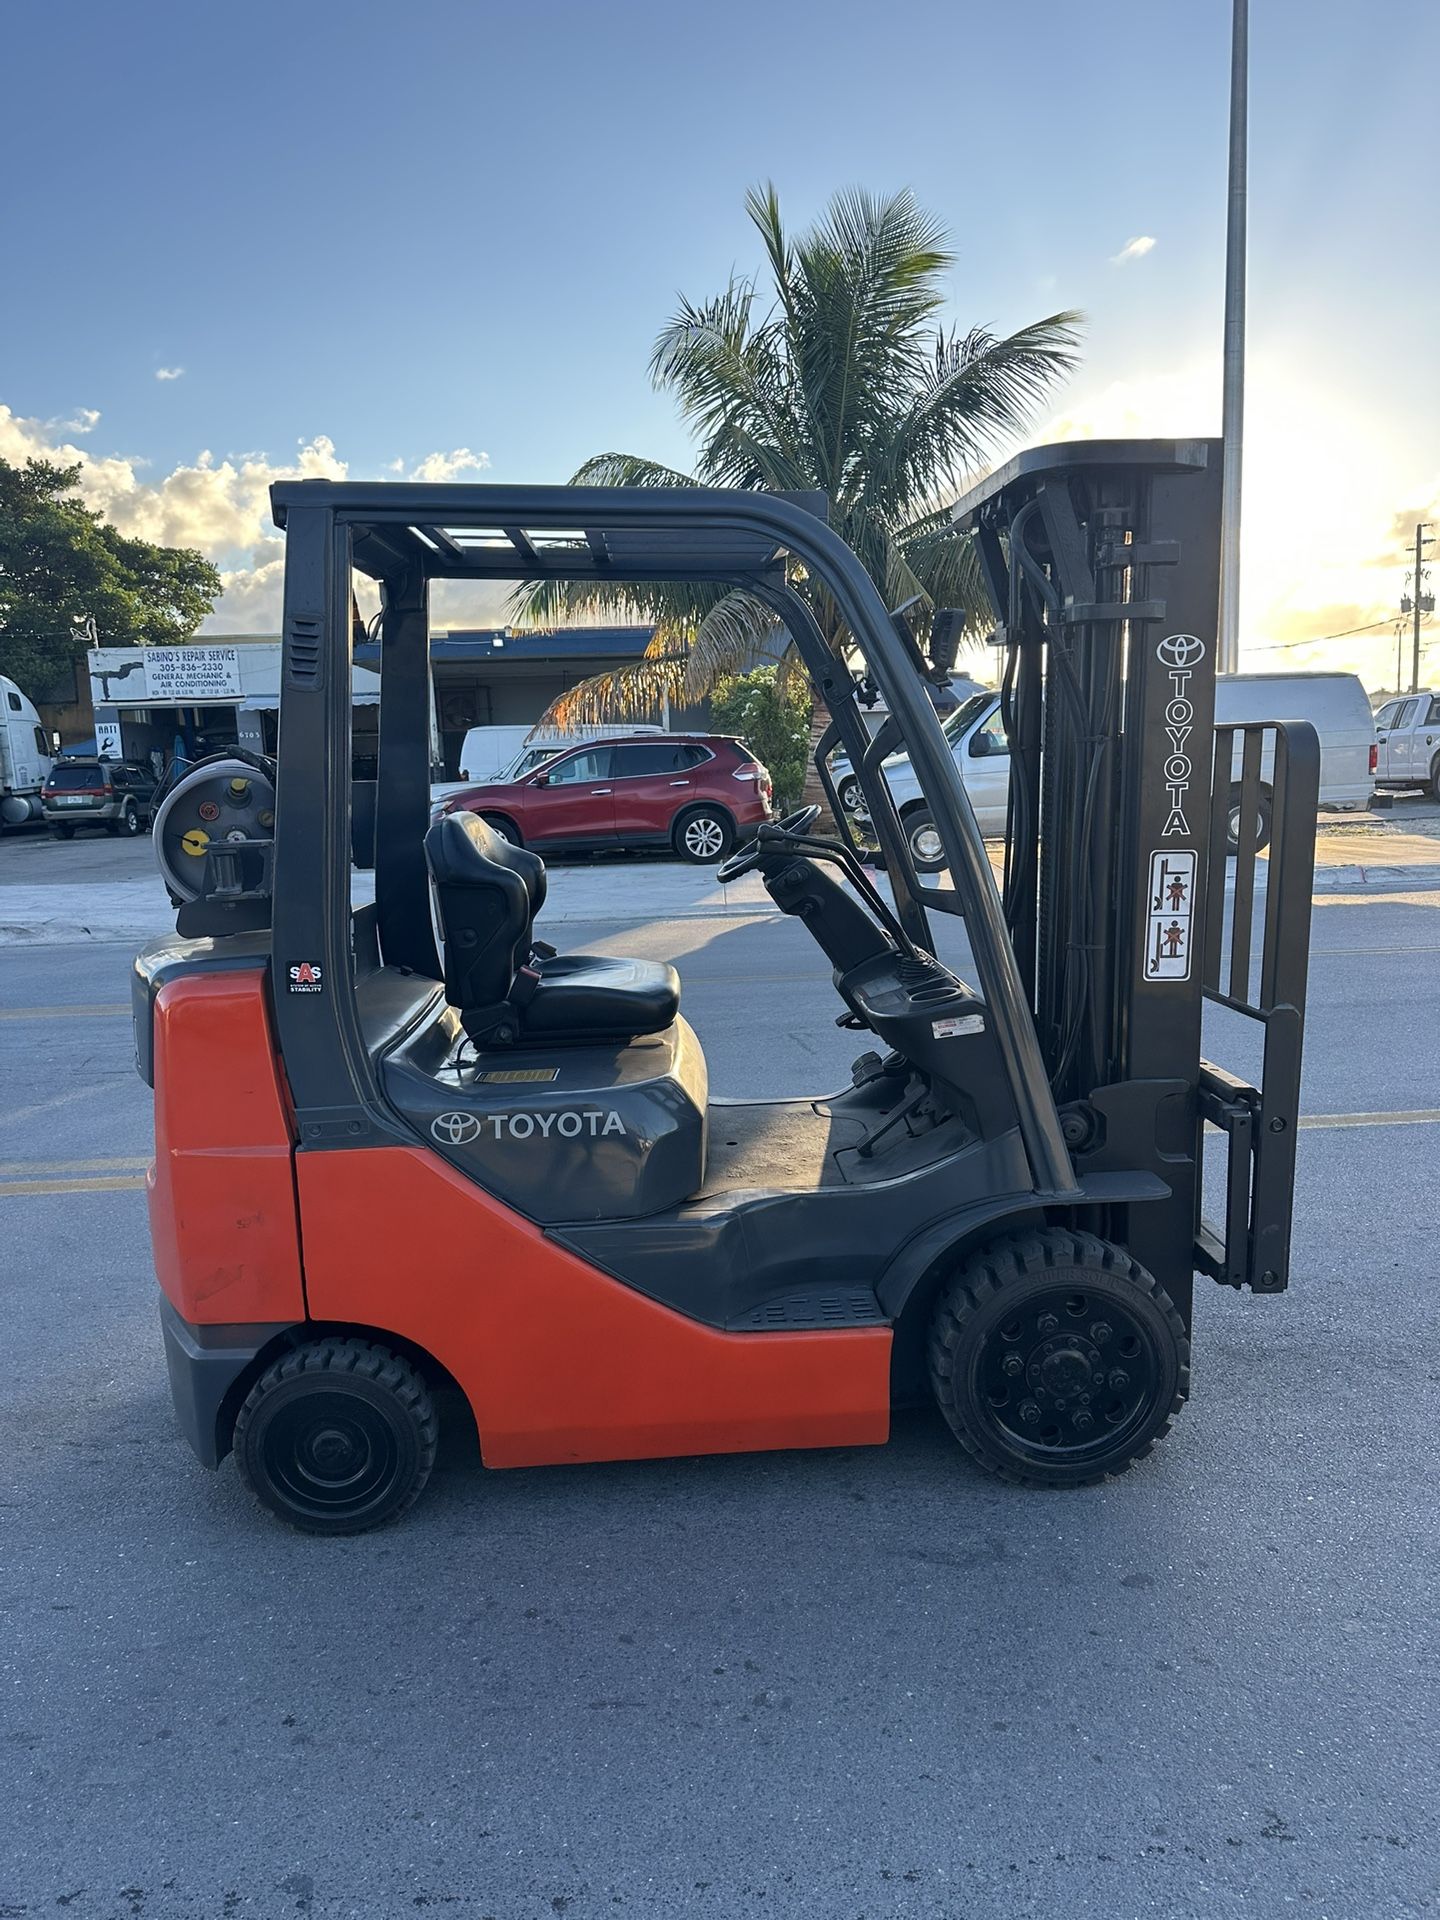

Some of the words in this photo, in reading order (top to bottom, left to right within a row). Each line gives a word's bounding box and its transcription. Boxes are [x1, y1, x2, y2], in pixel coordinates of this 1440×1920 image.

[147, 651, 180, 663] SABINO'S
[182, 650, 206, 662] REPAIR
[208, 650, 235, 661] SERVICE
[159, 663, 223, 672] 305-836-2330
[152, 672, 184, 680] GENERAL
[175, 680, 228, 688] CONDITIONING
[1161, 670, 1193, 836] TOYOTA
[290, 963, 321, 982] SAS
[487, 1111, 627, 1140] TOYOTA
